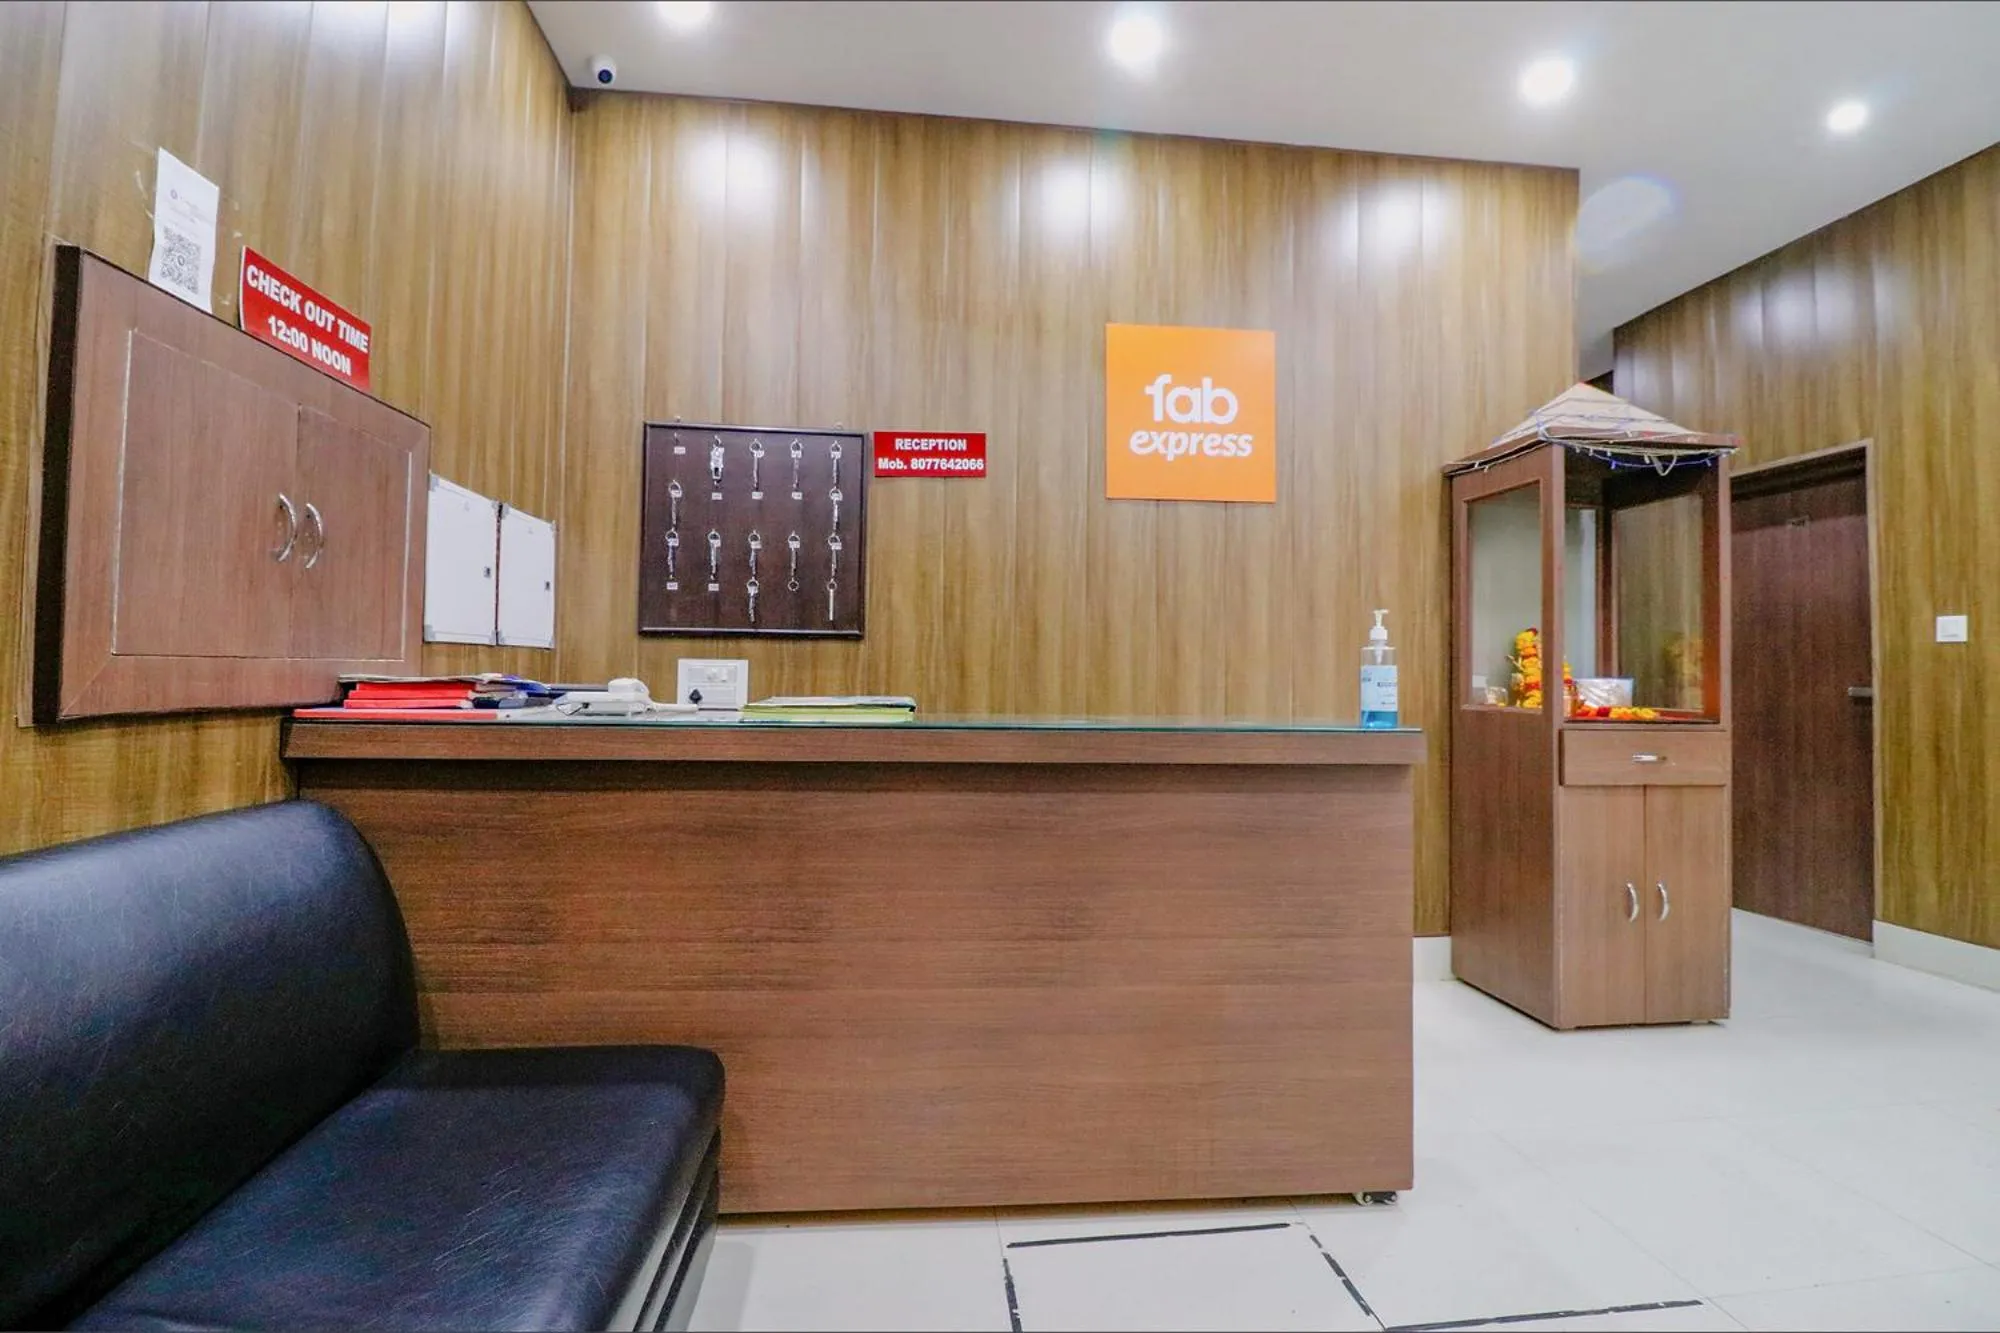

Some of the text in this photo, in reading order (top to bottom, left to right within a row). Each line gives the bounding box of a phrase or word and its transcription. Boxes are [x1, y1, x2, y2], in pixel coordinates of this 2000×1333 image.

[246, 264, 369, 354] CHECK OUT TIME
[268, 315, 352, 376] 12:00 NOON
[1144, 373, 1238, 425] fab
[878, 457, 907, 470] Mob.
[895, 438, 967, 451] RECEPTION
[1129, 429, 1254, 462] express
